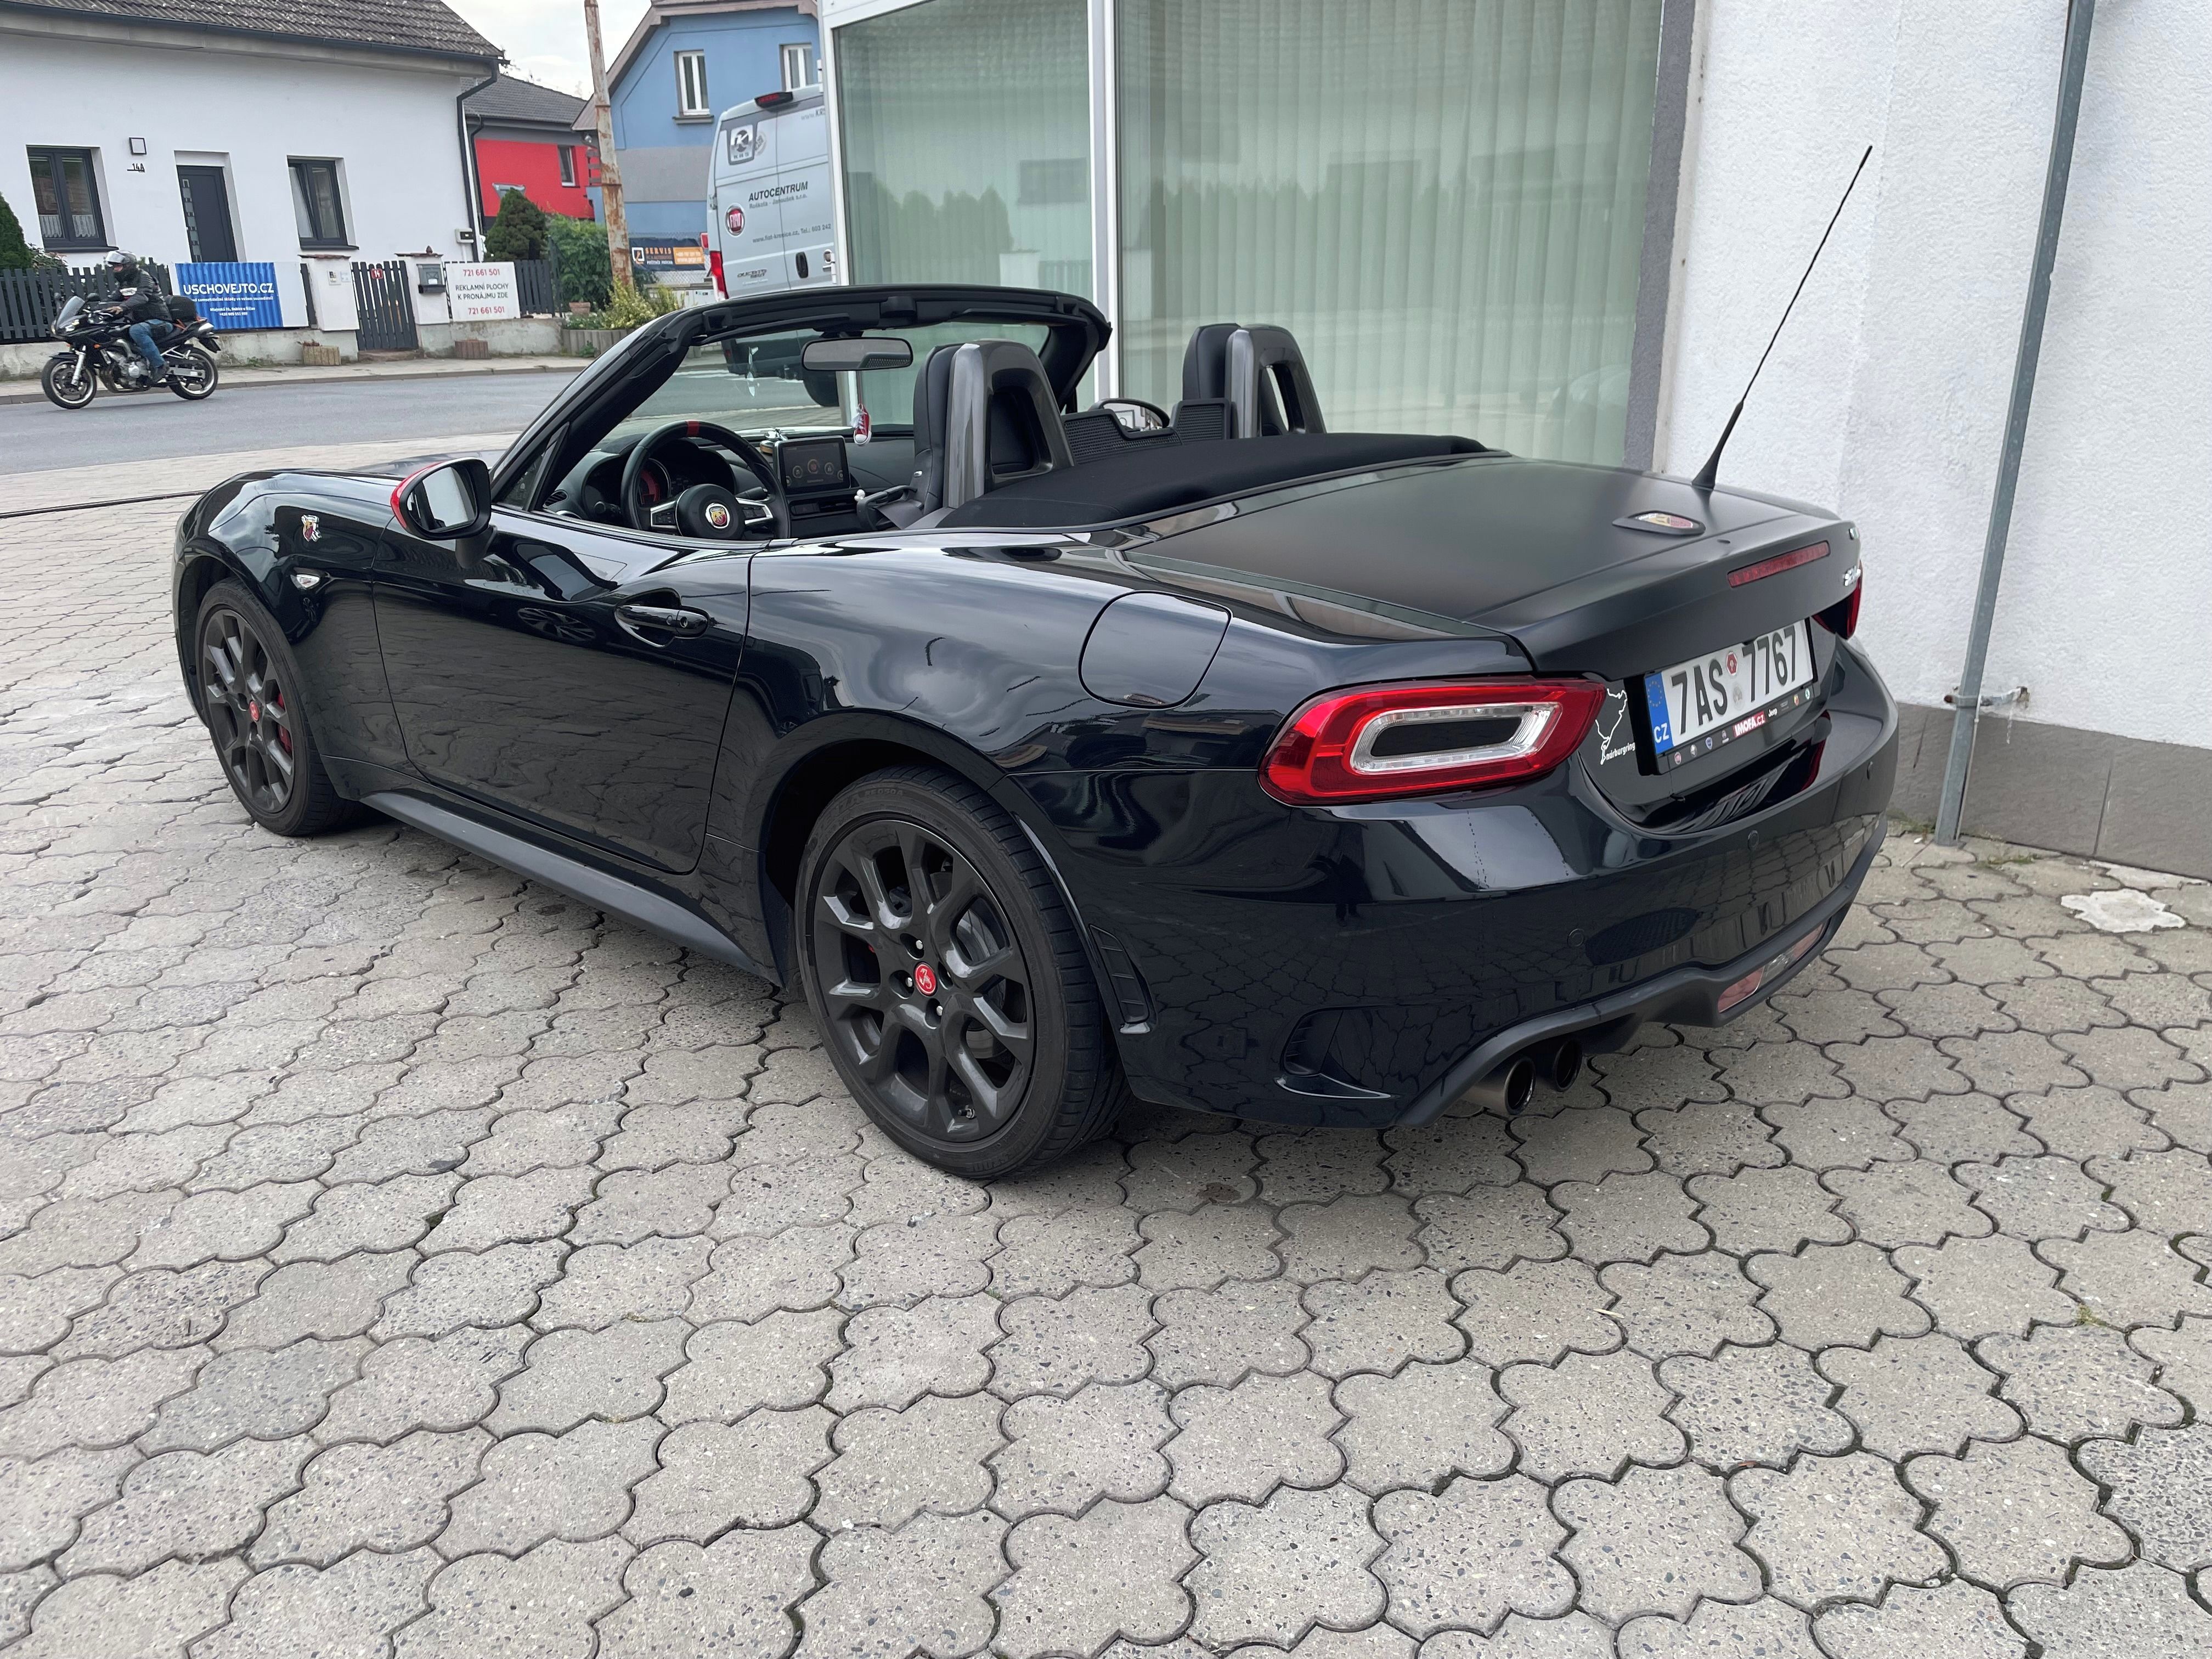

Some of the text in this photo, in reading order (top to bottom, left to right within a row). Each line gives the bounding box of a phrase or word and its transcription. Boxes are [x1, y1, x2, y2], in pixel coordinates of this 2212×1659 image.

[132, 163, 145, 172] 14A
[748, 181, 808, 201] AUTOCENTRUM
[730, 213, 741, 228] FIAT
[183, 283, 274, 295] USCHOVEJTO.CZ
[455, 282, 485, 291] REKLAMNÍ
[463, 291, 496, 300] PRONÁJMU
[1671, 624, 1796, 735] 7AS 7767
[1768, 708, 1778, 718] Jeep
[1734, 714, 1765, 737] IMOFA.CZ
[1654, 723, 1669, 743] CZ
